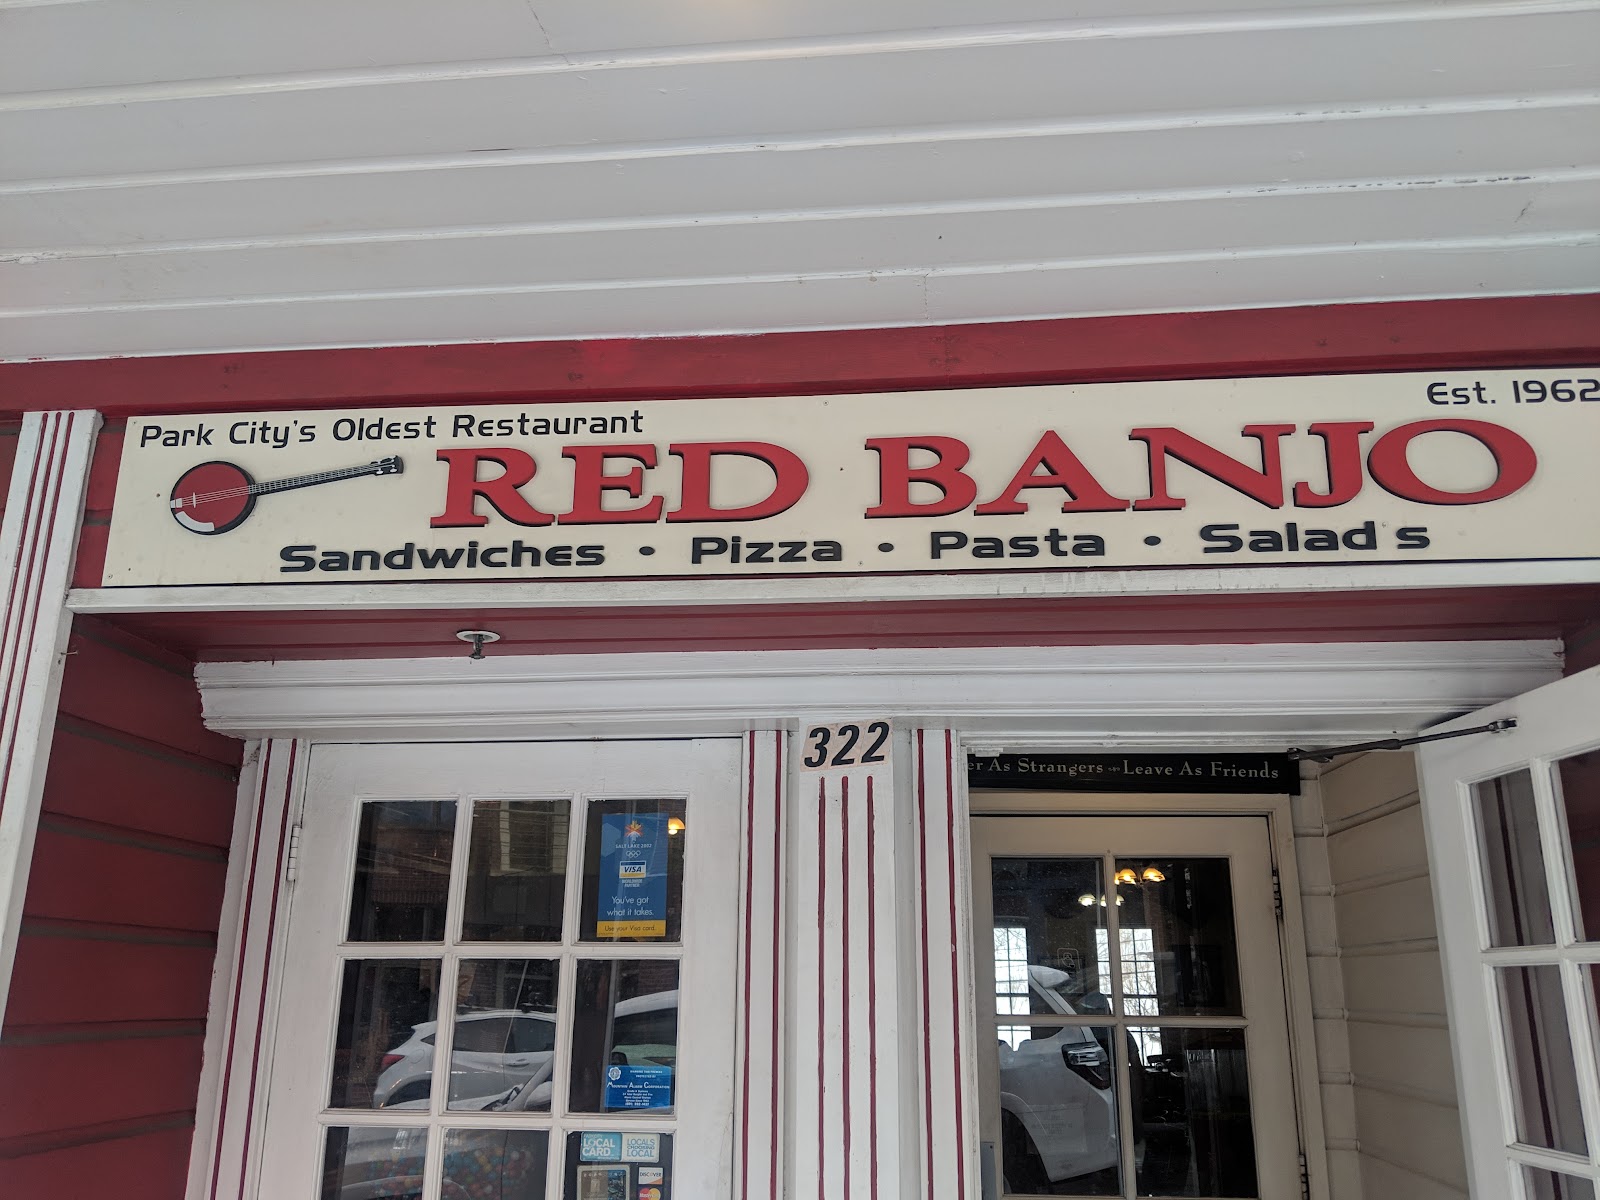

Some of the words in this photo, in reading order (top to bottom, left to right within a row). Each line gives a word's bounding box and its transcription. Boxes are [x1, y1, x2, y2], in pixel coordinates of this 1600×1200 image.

[1426, 381, 1497, 406] Est.
[1512, 378, 1600, 404] 1962
[140, 423, 214, 448] Park
[229, 420, 316, 449] City's
[333, 414, 437, 442] Oldest
[452, 410, 644, 438] Restaurant
[430, 441, 809, 529] RED
[864, 418, 1538, 520] BANJO
[280, 540, 605, 574] Sandwiches
[691, 535, 842, 565] Pizza
[930, 528, 1105, 560] Pasta
[803, 721, 890, 768] 322
[988, 758, 1011, 771] As
[1018, 757, 1104, 777] Strangers
[1123, 759, 1173, 776] Leave
[1178, 760, 1203, 776] As
[1210, 761, 1279, 779] Friends
[607, 907, 626, 916] what
[627, 907, 632, 916] it
[634, 906, 654, 916] takes.
[612, 896, 635, 905] You've
[636, 896, 649, 906] got
[582, 1147, 611, 1157] CARD
[584, 1138, 616, 1148] LOCAL
[627, 1150, 655, 1158] LOCAL
